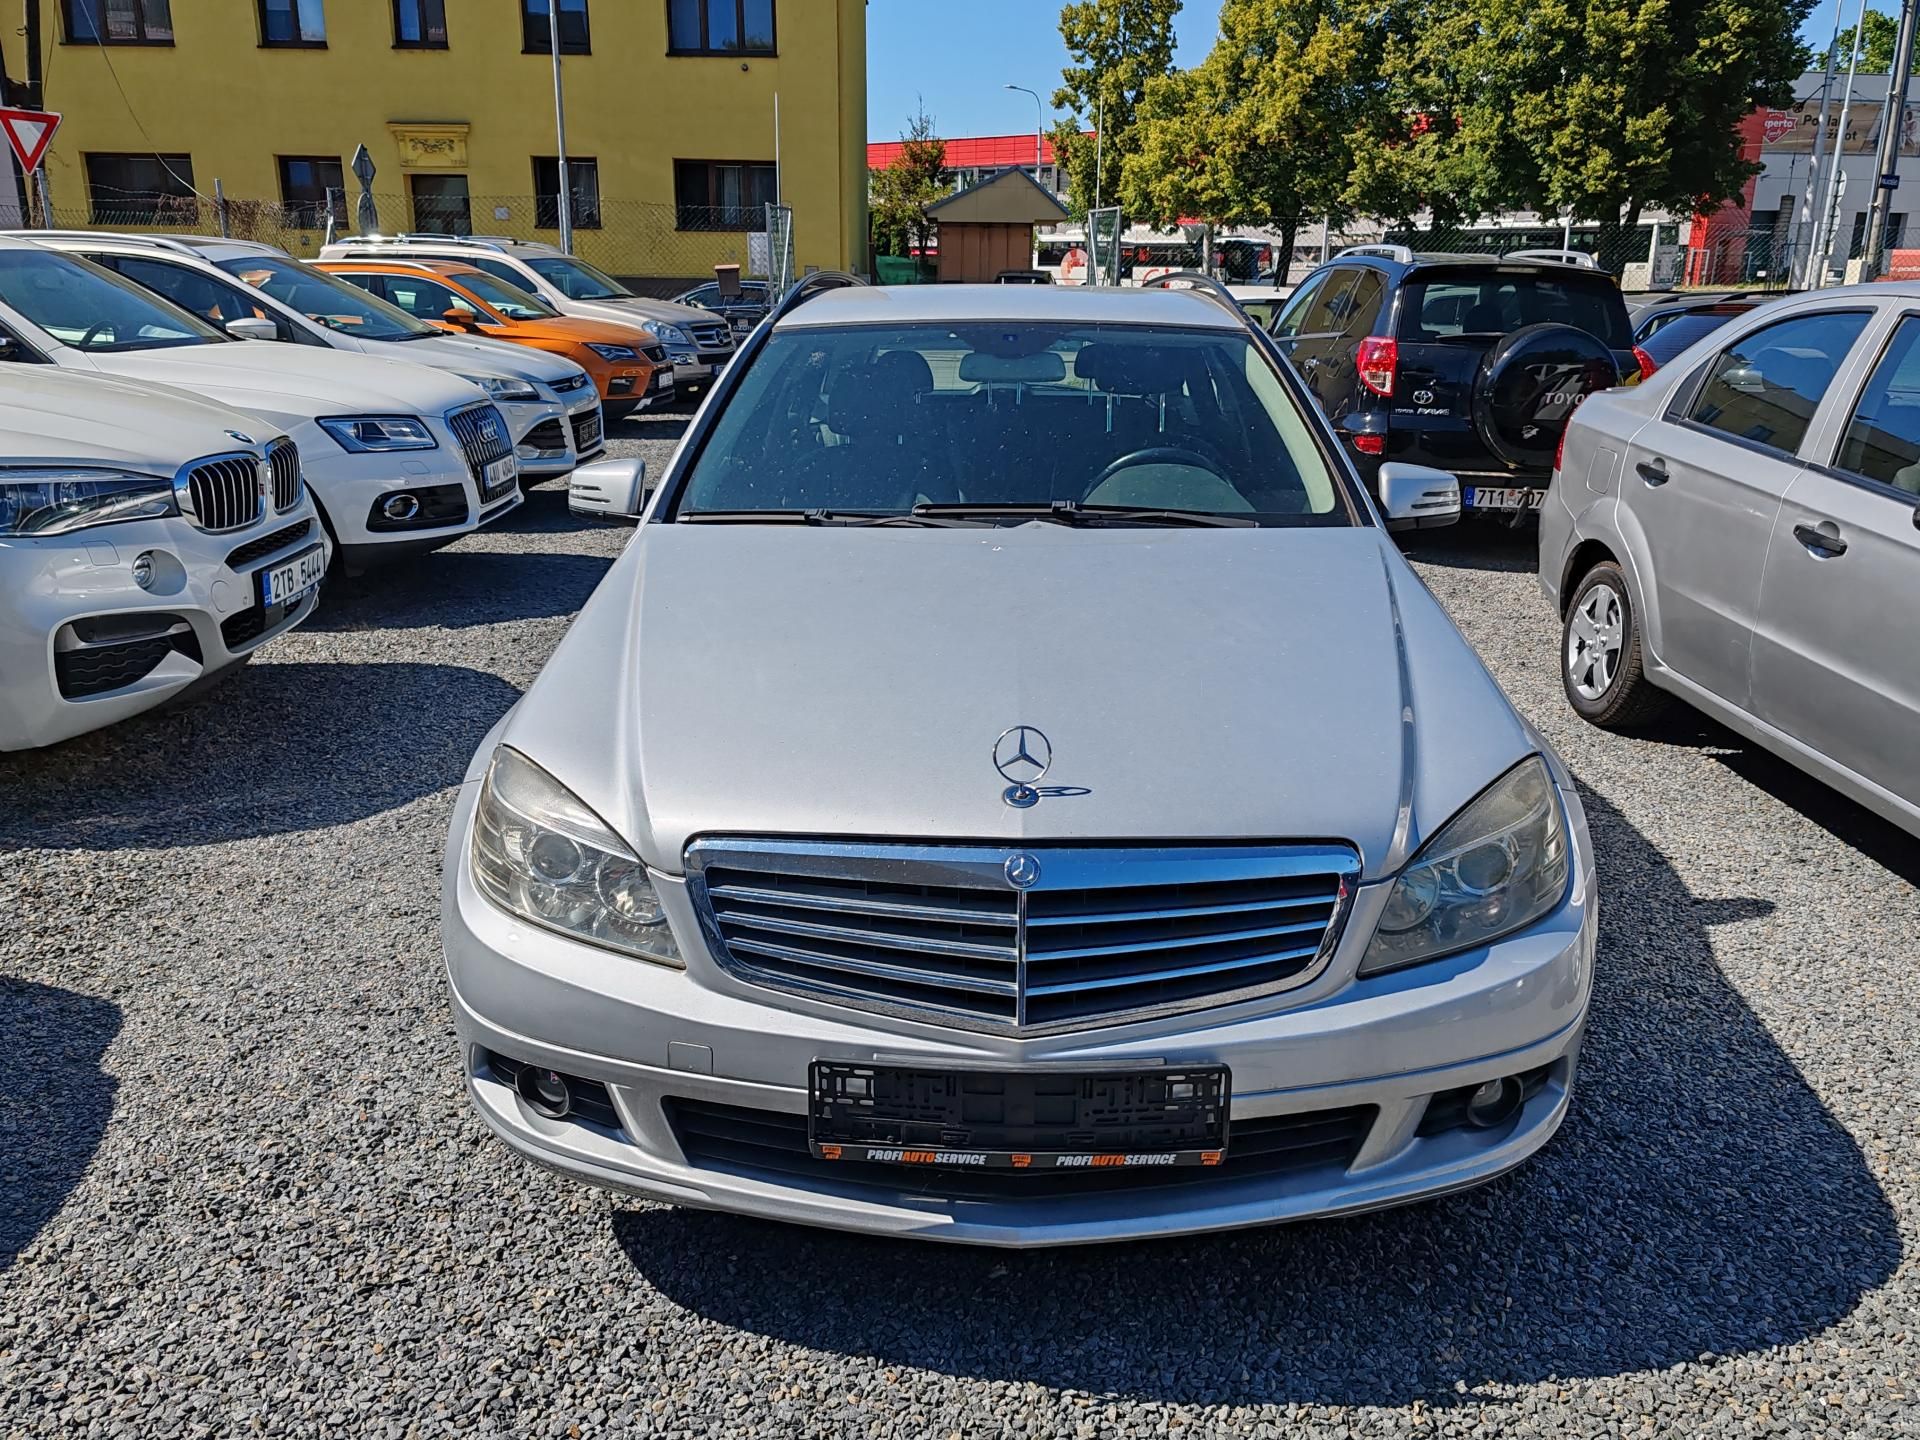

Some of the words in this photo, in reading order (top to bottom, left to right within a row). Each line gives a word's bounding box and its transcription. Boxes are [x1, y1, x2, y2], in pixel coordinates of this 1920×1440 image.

[1802, 114, 1854, 128] Polay
[1827, 130, 1857, 141] žiot
[1545, 392, 1586, 405] TOYO
[1477, 489, 1505, 506] 7T1
[273, 567, 295, 600] 2TB
[300, 553, 321, 586] 5444
[866, 1149, 987, 1165] PROFIAUTOSERVICE
[1056, 1153, 1177, 1167] PROFIAUTOSERVICE
